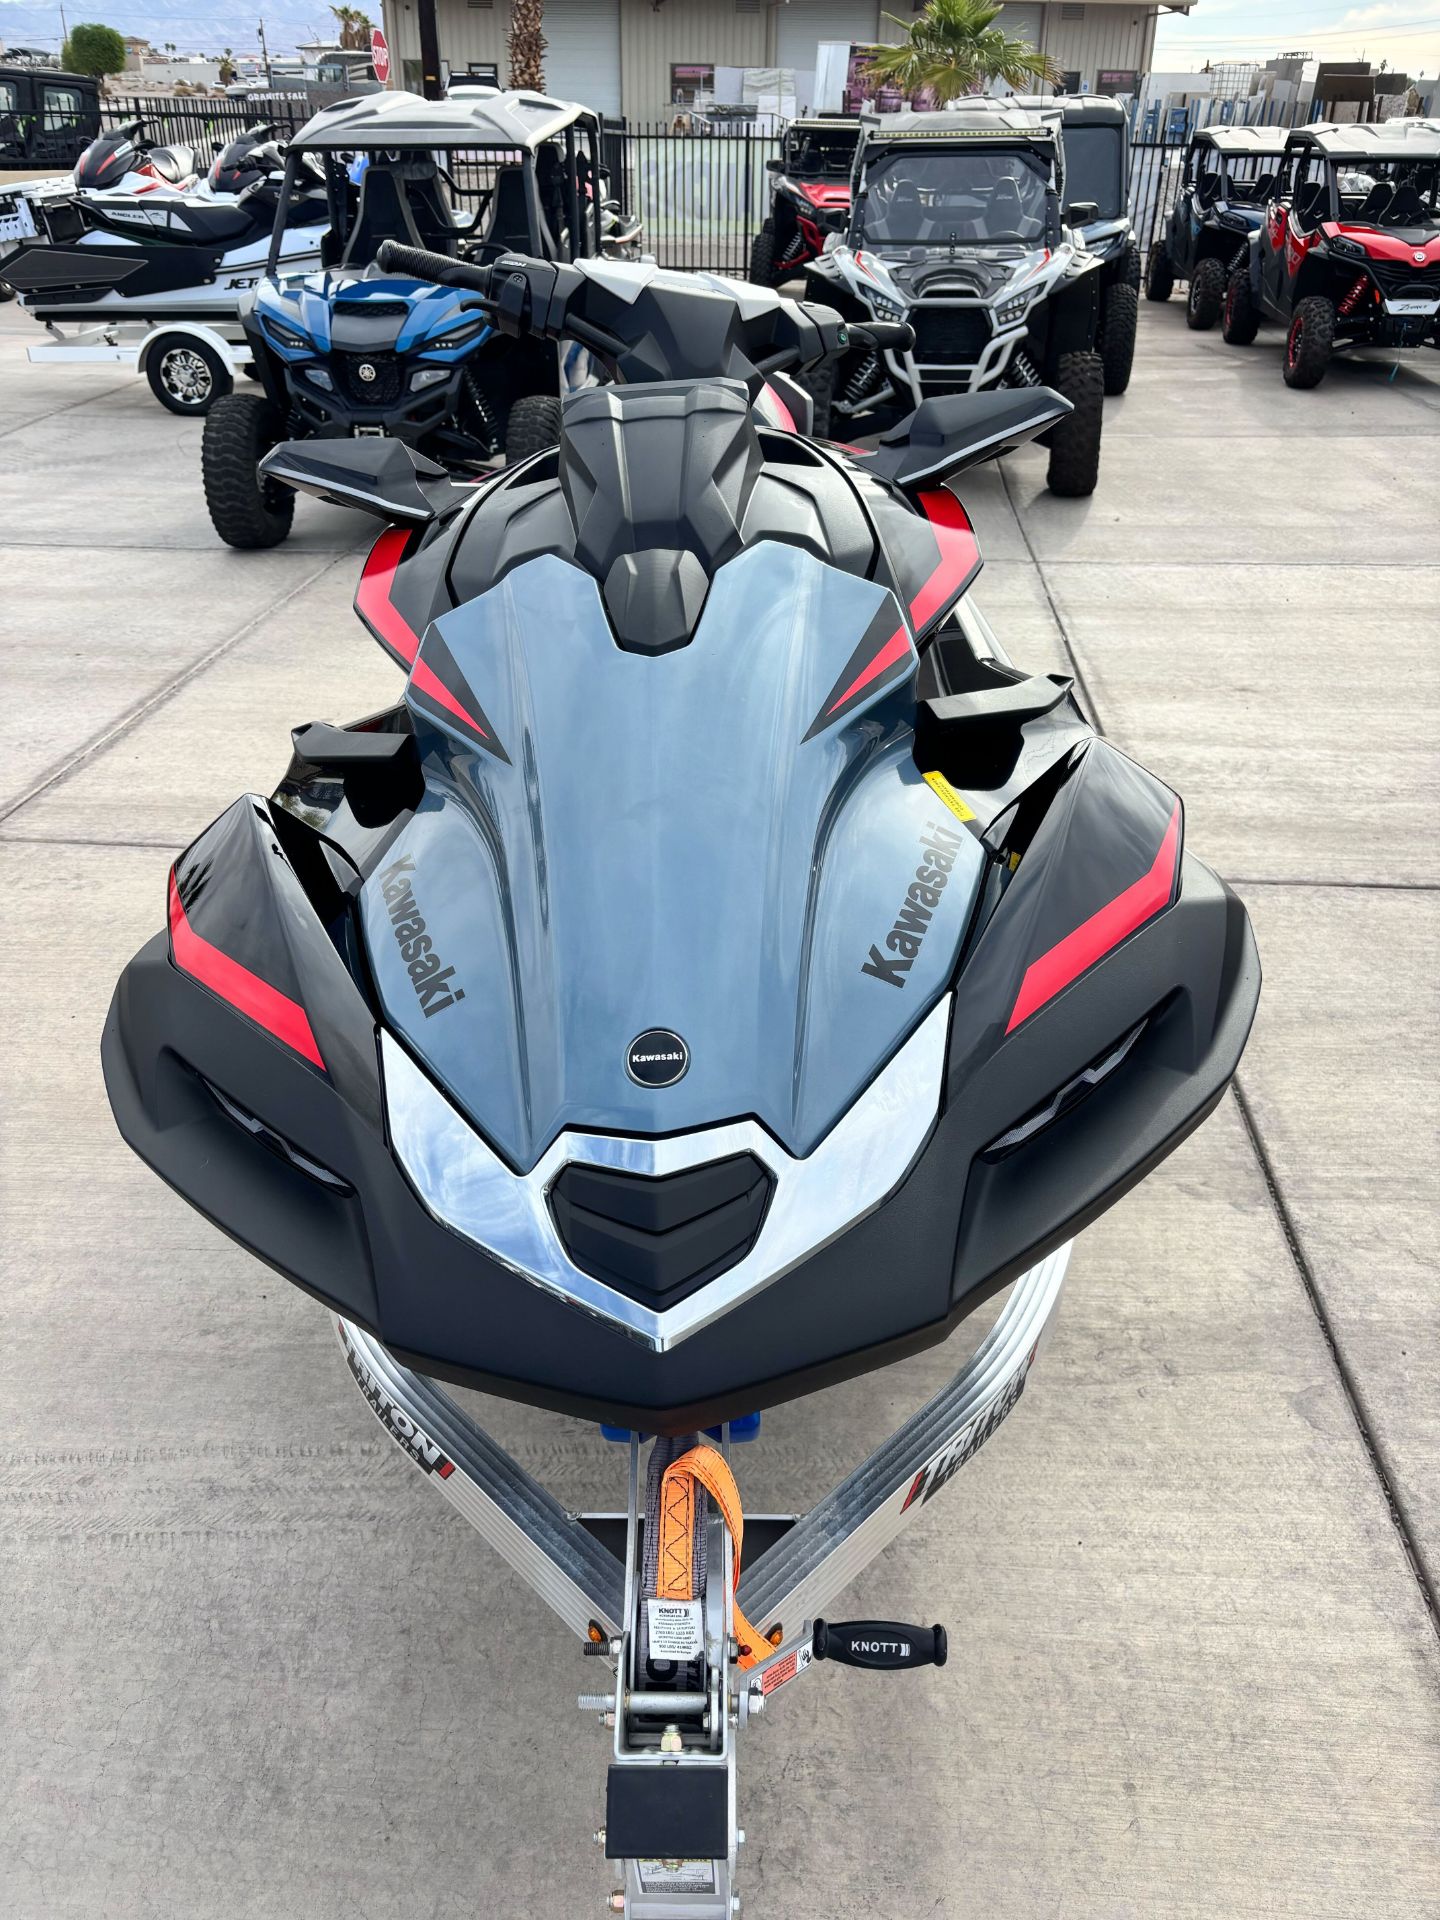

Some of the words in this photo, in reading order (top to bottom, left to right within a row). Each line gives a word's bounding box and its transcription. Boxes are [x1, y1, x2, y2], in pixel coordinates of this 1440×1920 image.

[373, 46, 388, 66] STOP
[248, 92, 285, 101] GRANITE
[111, 211, 144, 220] ANGLER
[861, 821, 963, 988] Kawasaki
[379, 853, 466, 1018] Kawasaki
[632, 1052, 683, 1063] Kawasaki
[356, 1372, 420, 1461] TRAILERS
[851, 1641, 898, 1653] KNOTT
